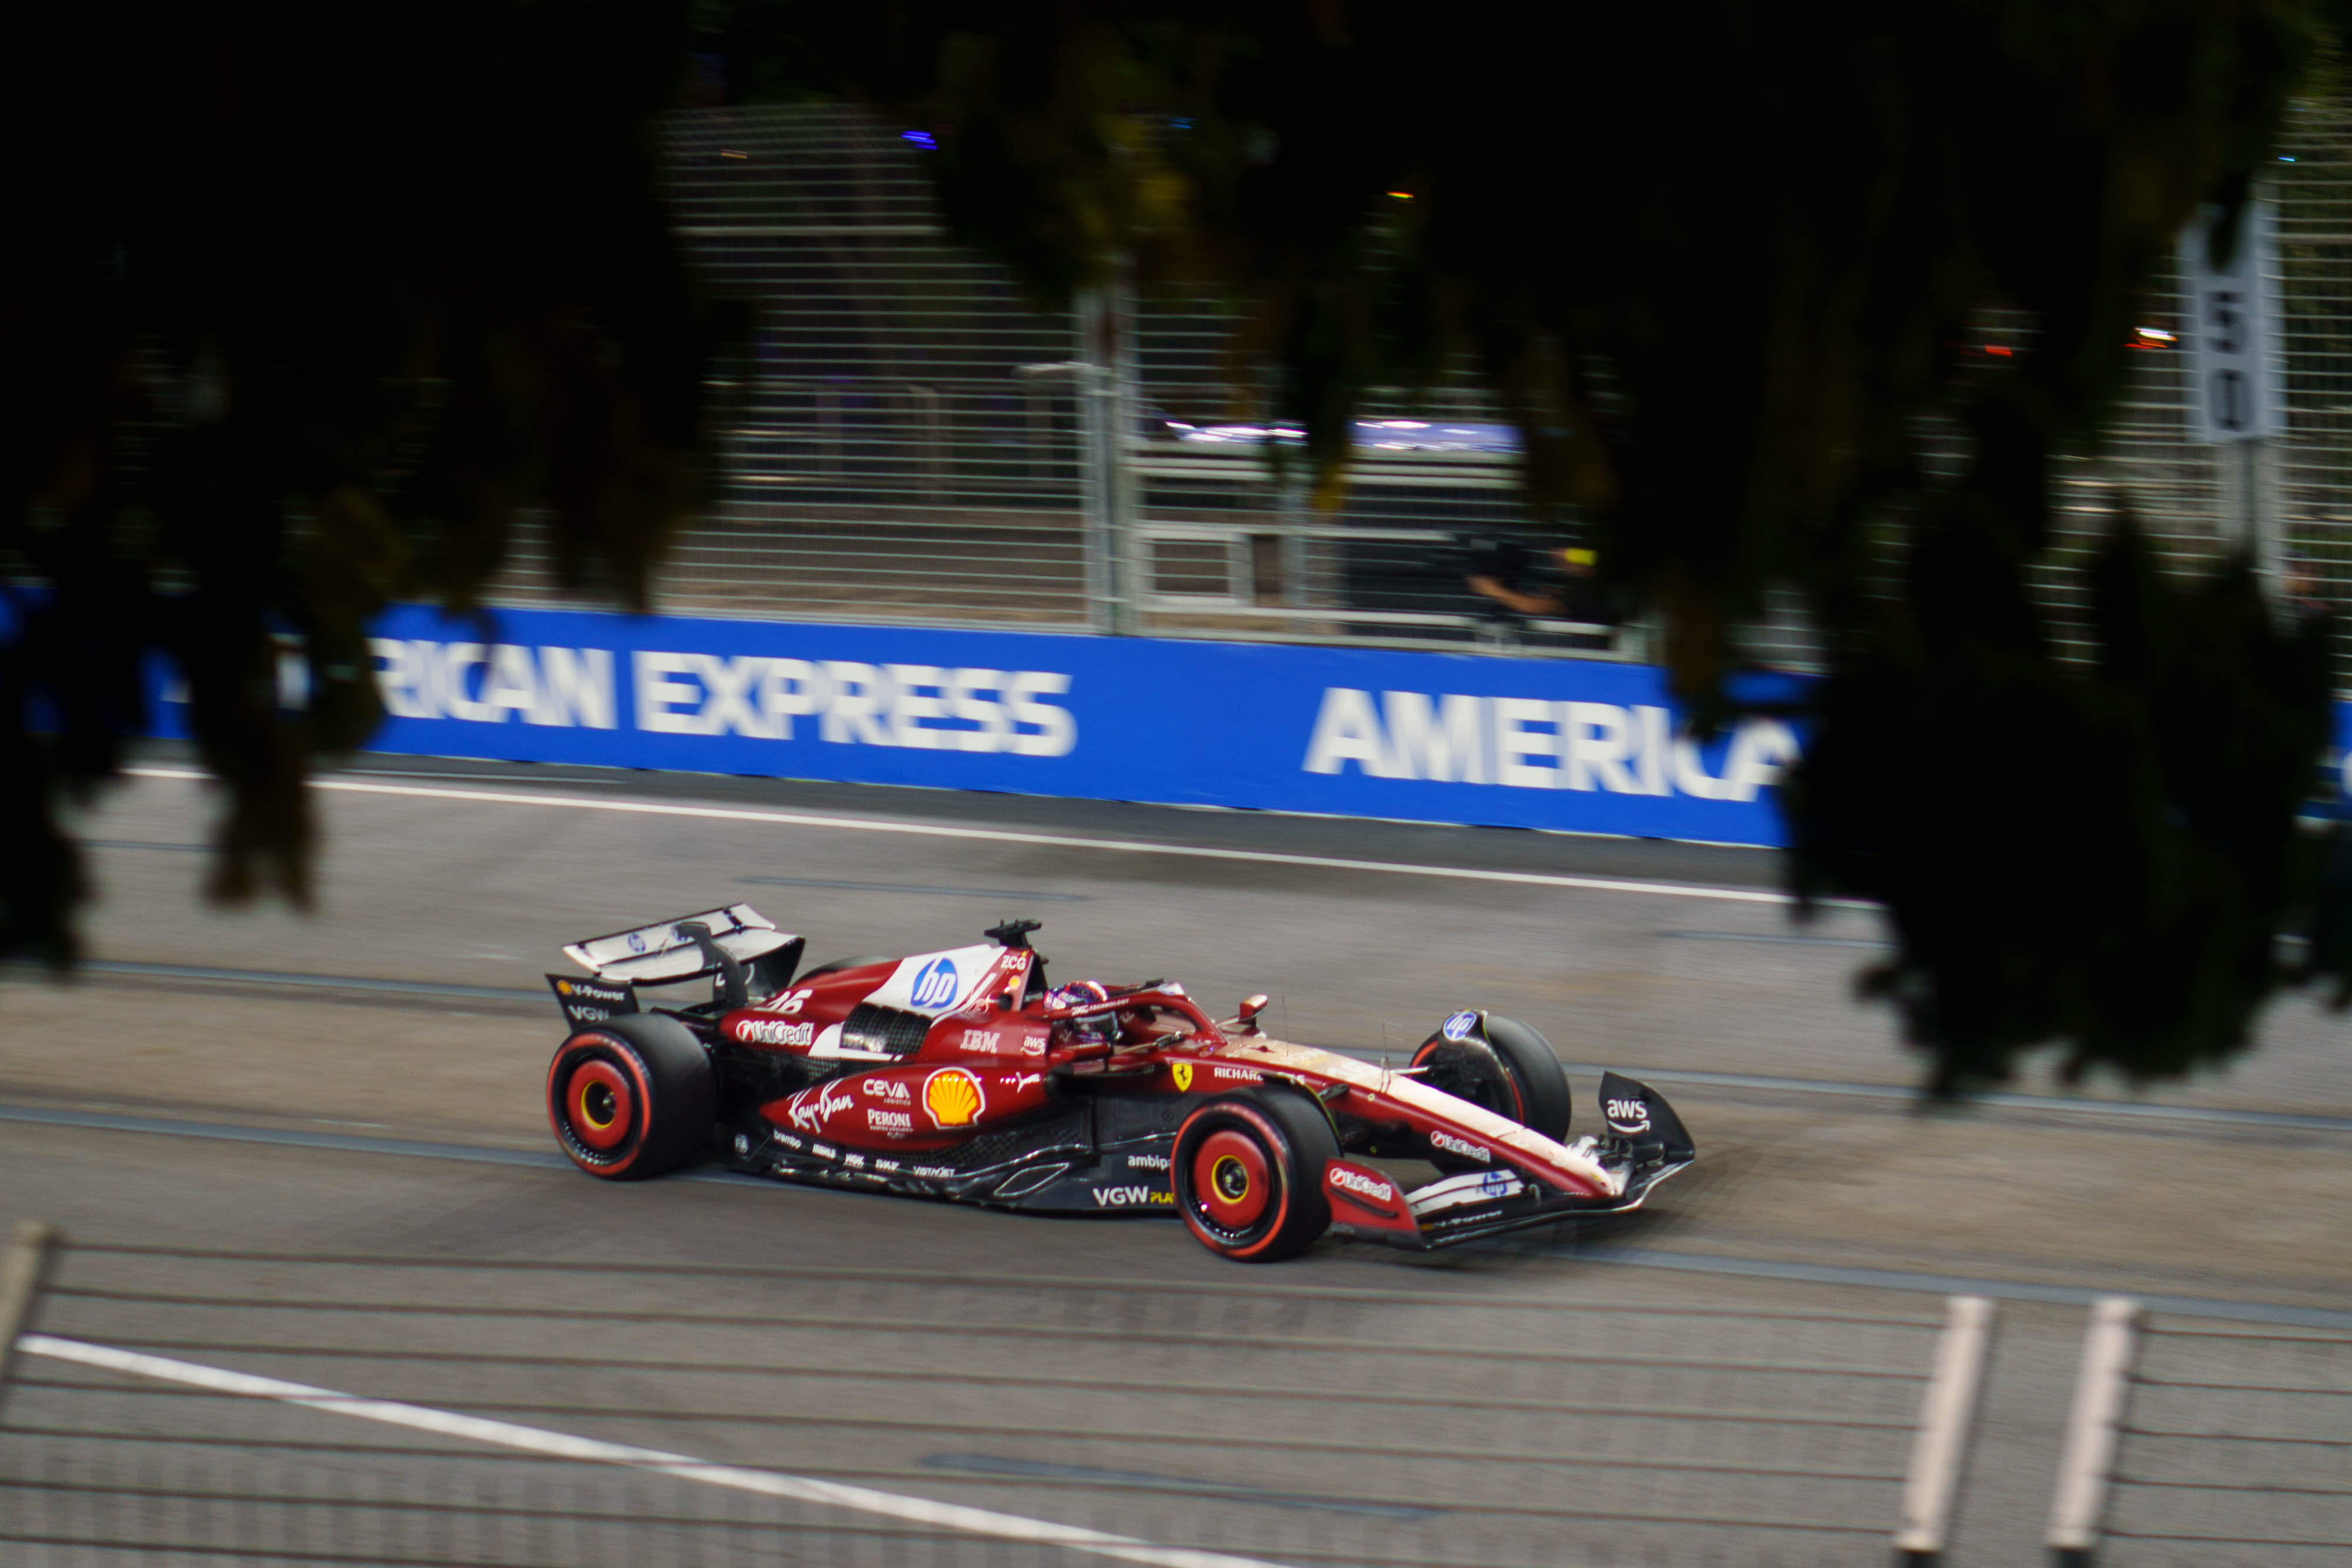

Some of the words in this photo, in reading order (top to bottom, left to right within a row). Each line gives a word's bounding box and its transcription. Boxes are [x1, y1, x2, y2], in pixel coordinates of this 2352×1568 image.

[2198, 268, 2257, 433] 50
[632, 650, 1078, 757] EXPRESS
[1301, 687, 1804, 802] AMERICA
[1001, 955, 1027, 971] ZCG
[911, 957, 958, 1007] hp
[568, 1004, 609, 1021] VGW
[753, 1020, 814, 1045] UniCredit
[960, 1029, 1001, 1054] IBM
[1023, 1036, 1046, 1048] aws
[867, 1109, 911, 1128] PERONI
[1607, 1099, 1648, 1119] aws
[773, 1128, 802, 1149] brembo
[1093, 1185, 1149, 1206] VGW
